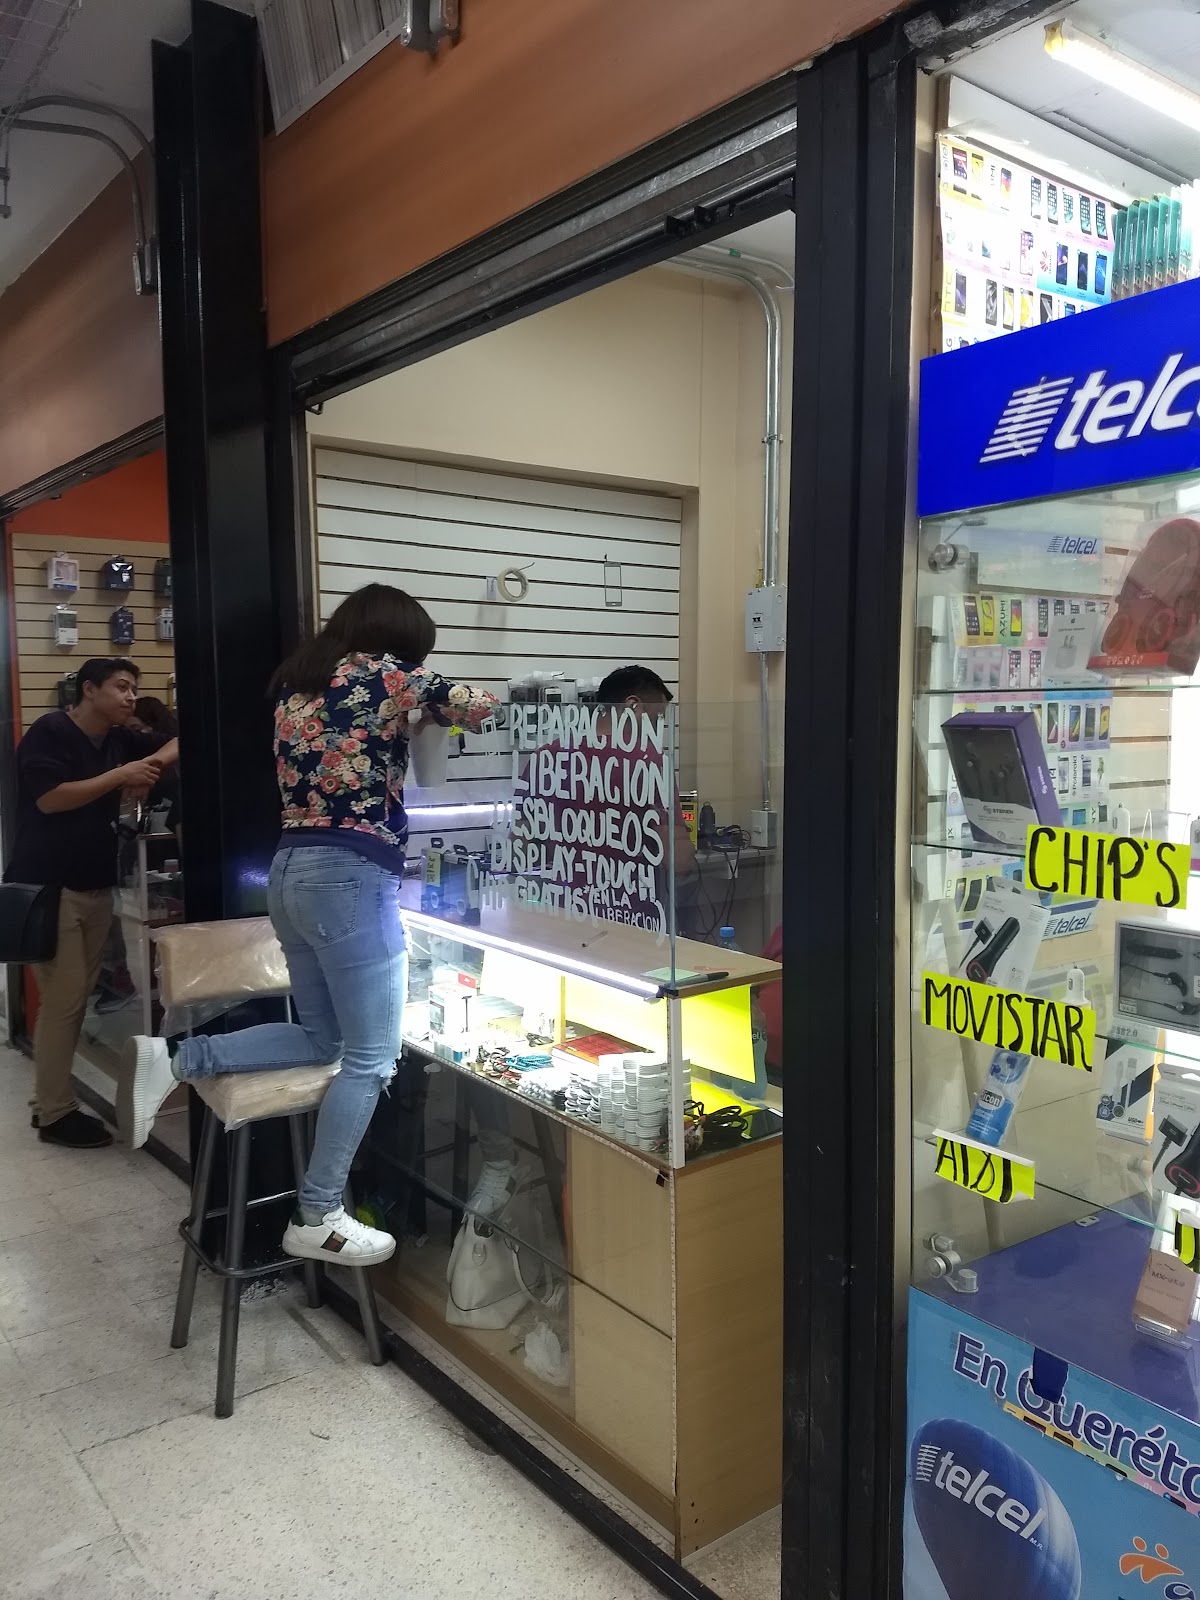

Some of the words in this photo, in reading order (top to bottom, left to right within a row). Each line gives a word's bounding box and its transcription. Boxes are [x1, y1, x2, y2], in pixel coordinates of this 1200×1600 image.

[1054, 353, 1200, 450] telc
[1061, 536, 1097, 555] telcel
[510, 703, 665, 754] REPARACION
[511, 749, 670, 813] LIBERACIÓN
[493, 795, 664, 866] DESBLOQUEOS
[491, 837, 656, 903] DISPLAY-TOUCH
[609, 890, 632, 909] LA
[1029, 827, 1180, 908] CHIP'S
[1052, 912, 1092, 936] telcel
[925, 978, 1093, 1073] MOVISTAR
[954, 1333, 1007, 1397] En
[935, 1451, 1047, 1539] telcel
